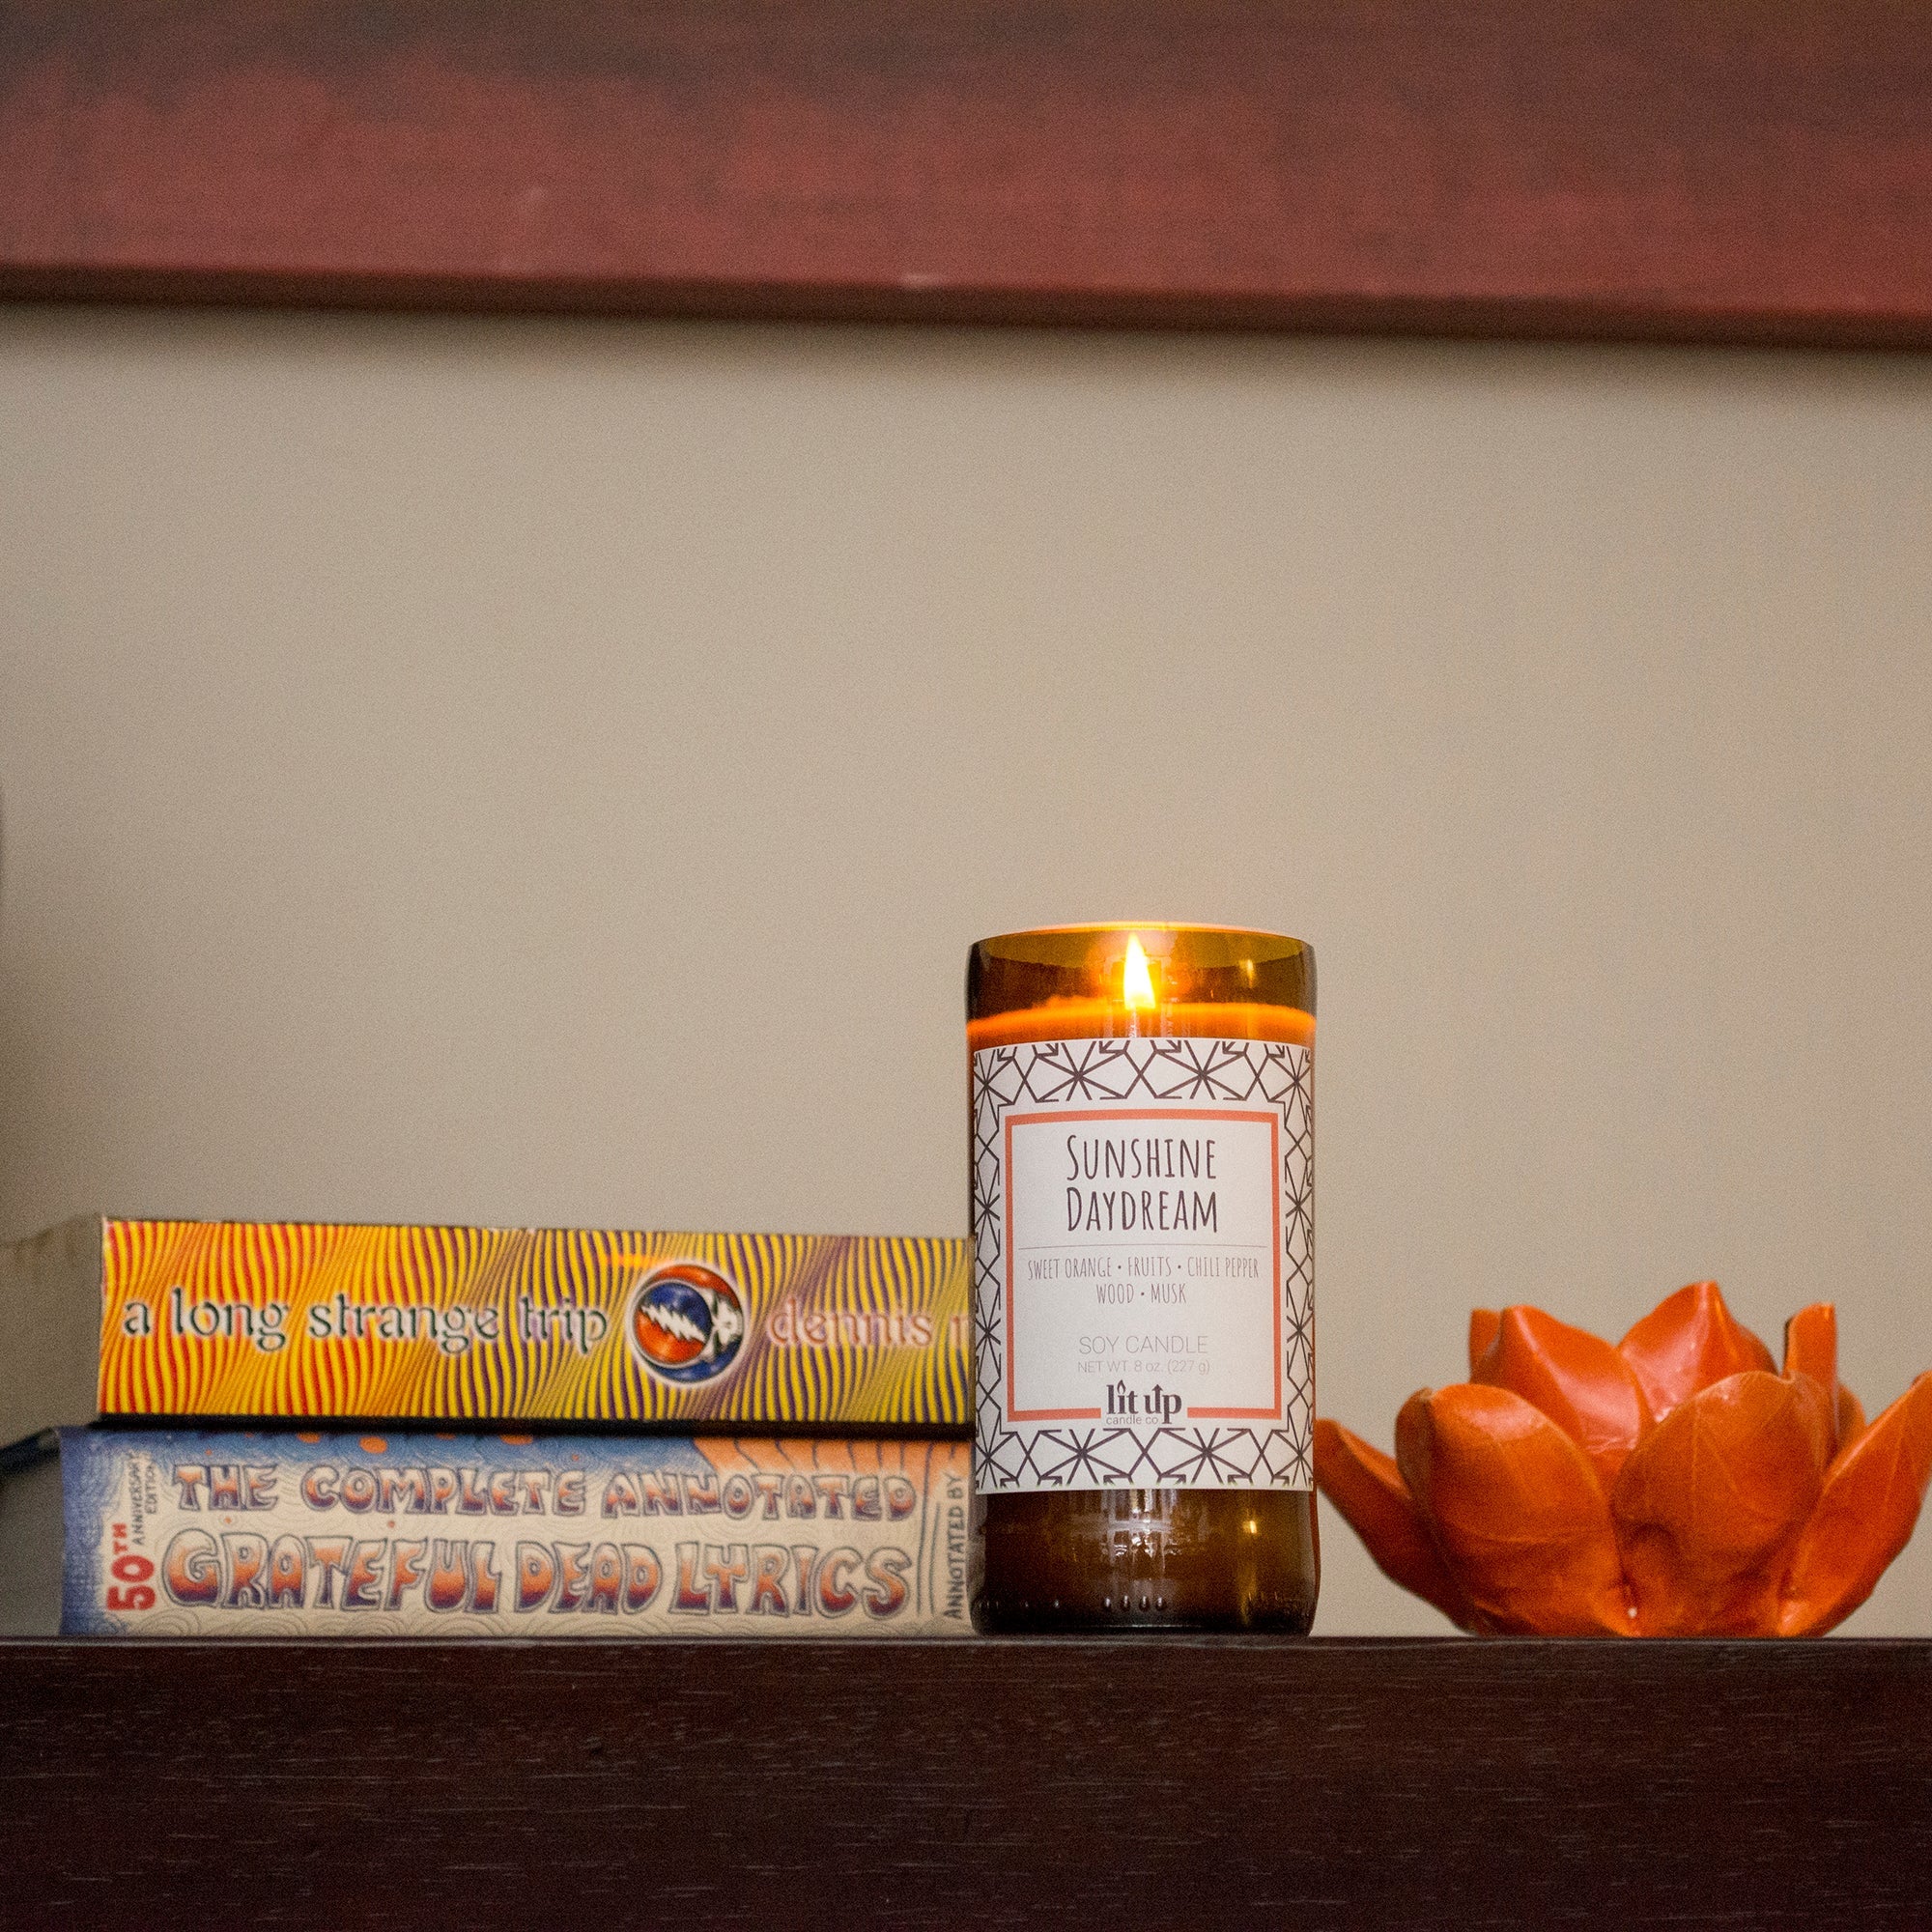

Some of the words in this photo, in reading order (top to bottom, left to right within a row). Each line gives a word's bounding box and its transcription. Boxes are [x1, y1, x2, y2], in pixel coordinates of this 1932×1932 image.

[1066, 1134, 1217, 1180] SUNSHINE
[1066, 1186, 1218, 1233] DAYDREAM
[1028, 1258, 1061, 1281] SWEET
[1065, 1257, 1112, 1279] ORANGE
[1127, 1256, 1172, 1278] FRUITS
[1187, 1256, 1220, 1278] CHILI
[1225, 1257, 1260, 1279] PEPPER
[1095, 1284, 1134, 1304] WOOD
[1151, 1283, 1187, 1304] MUSK
[123, 1300, 151, 1335] a
[171, 1287, 289, 1352] long
[307, 1293, 500, 1354] strange
[518, 1294, 608, 1354] trip
[769, 1297, 933, 1347] dennis
[1077, 1360, 1104, 1374] NET
[1133, 1359, 1143, 1373] 8
[1145, 1362, 1164, 1373] oz.
[1167, 1358, 1196, 1376] (227
[1198, 1359, 1210, 1376] g)
[1079, 1336, 1120, 1354] SOY
[1125, 1335, 1209, 1354] CANDLE
[1105, 1414, 1143, 1426] candle
[1106, 1379, 1139, 1415] lit
[1144, 1384, 1182, 1425] up
[173, 1463, 278, 1512] THE
[300, 1463, 586, 1517] COMPLETE
[601, 1467, 917, 1522] ANNOTATED
[943, 1471, 963, 1499] BY
[161, 1528, 502, 1613] GRATEFUL
[513, 1539, 664, 1615] DEAD
[668, 1540, 913, 1619] LYRICS
[943, 1505, 965, 1620] ANNOTATED
